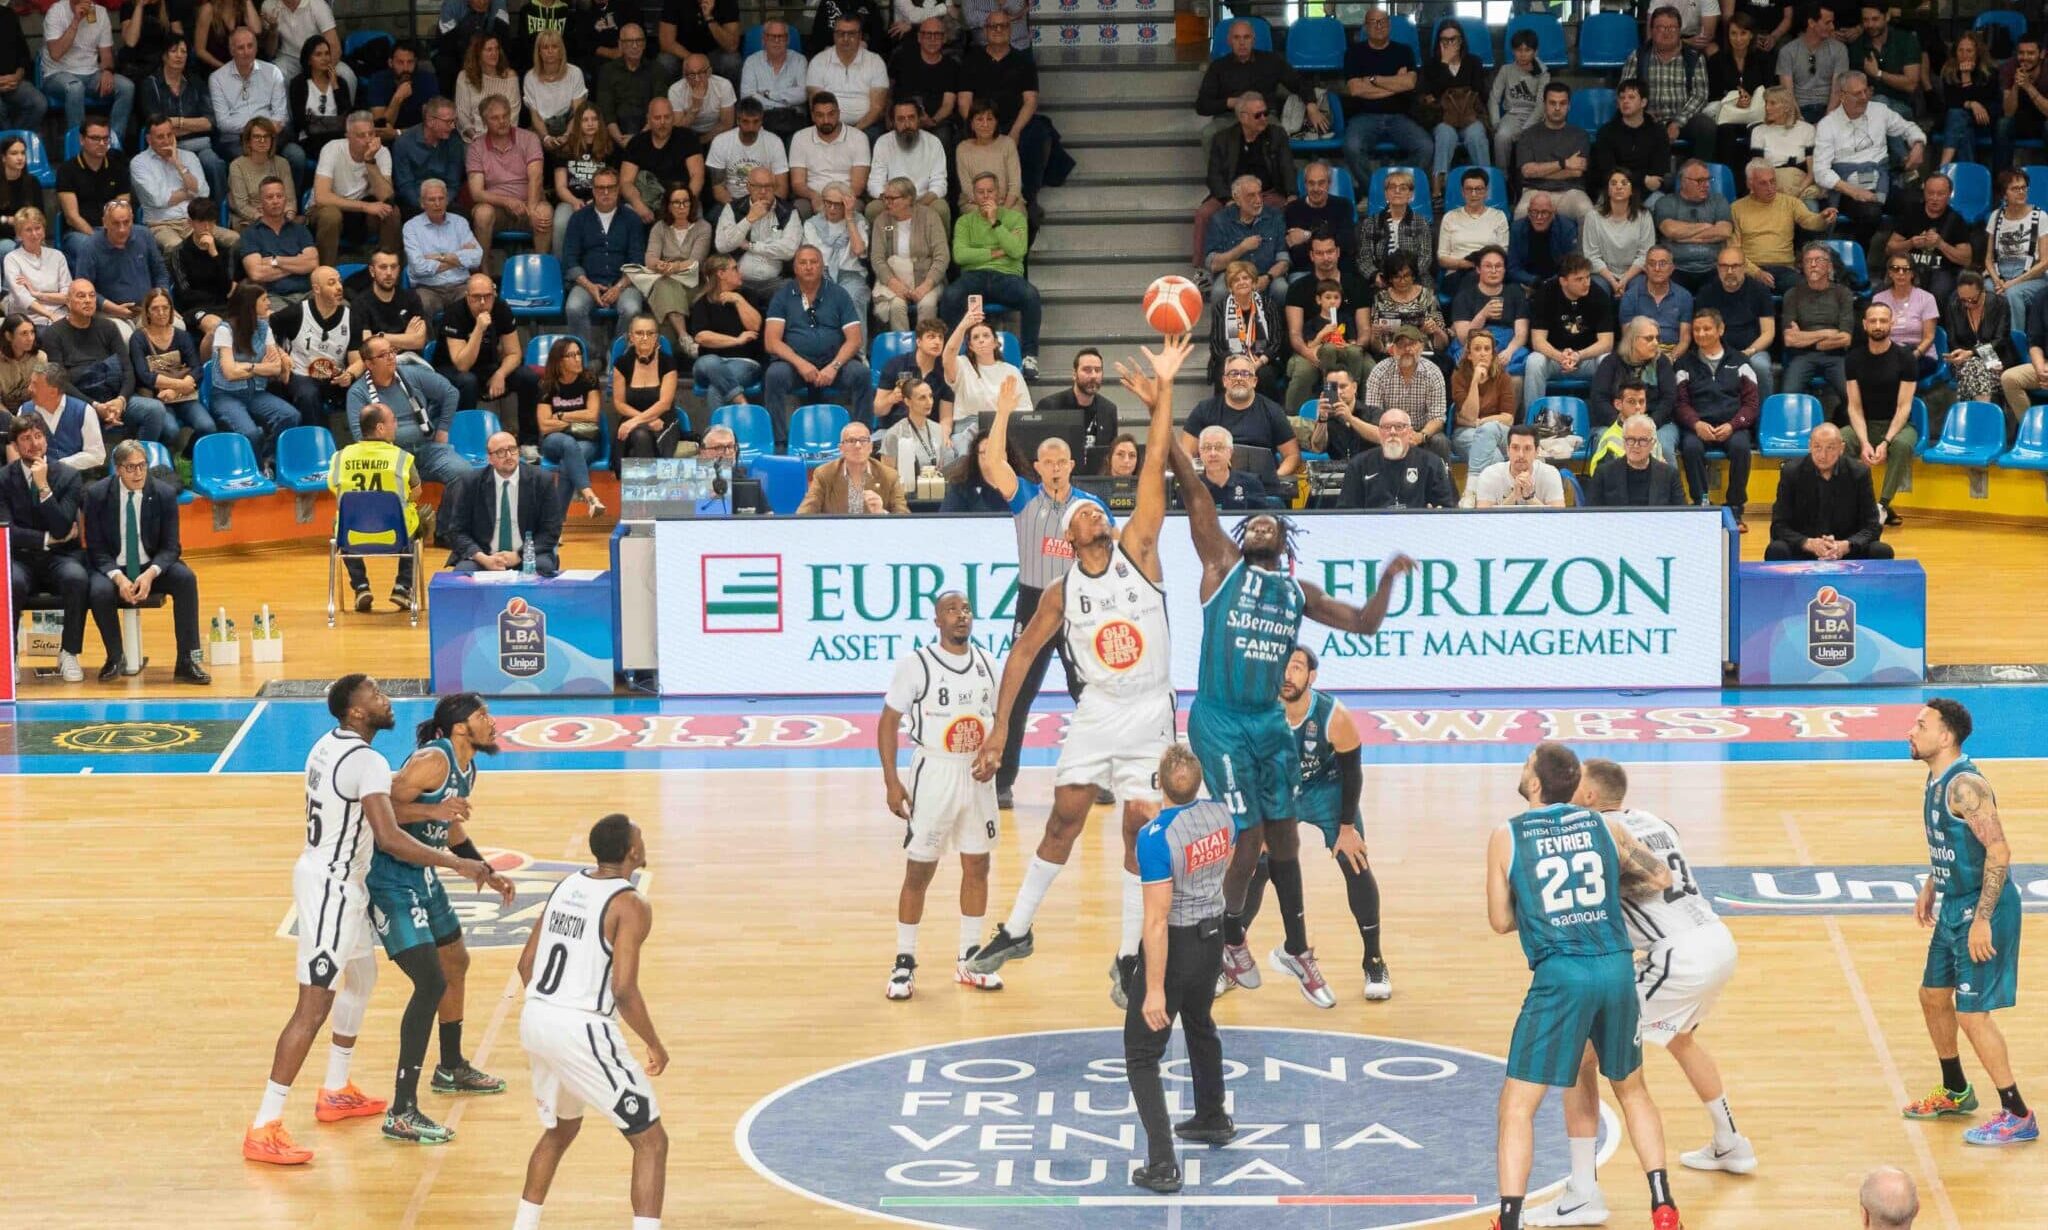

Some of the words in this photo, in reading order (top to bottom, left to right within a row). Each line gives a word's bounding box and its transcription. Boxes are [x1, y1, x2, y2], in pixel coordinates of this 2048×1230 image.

[345, 460, 389, 470] STEWARD
[351, 473, 382, 491] 34
[805, 563, 1019, 621] EURIZ
[1242, 571, 1263, 597] 11
[1318, 556, 1676, 617] EURIZON
[1079, 594, 1091, 614] 6
[505, 630, 540, 643] LBA
[1103, 624, 1129, 640] OLD
[1814, 619, 1849, 633] LBA
[808, 634, 901, 661] ASSET
[1102, 636, 1136, 652] WILD
[1320, 630, 1413, 657] ASSET
[1423, 628, 1677, 657] MANAGEMENT
[1818, 646, 1847, 660] Unipol
[509, 656, 538, 670] Unipol
[1104, 648, 1139, 664] WEST
[1243, 650, 1279, 662] ARENA
[938, 687, 950, 706] 8
[502, 714, 861, 748] OLD
[955, 720, 978, 732] OLD
[1368, 706, 1878, 742] WEST
[1224, 791, 1247, 814] 11
[306, 792, 323, 847] 5
[986, 820, 996, 839] 8
[1191, 844, 1227, 866] GROUP
[1192, 831, 1226, 857] ATTAL
[1536, 832, 1593, 857] FEVRIER
[1536, 851, 1606, 914] 23
[548, 911, 587, 940] CHRISTON
[536, 943, 568, 995] 0
[907, 1057, 1036, 1083] IO
[1083, 1057, 1459, 1083] SONO
[901, 1090, 1234, 1116] FRIULI
